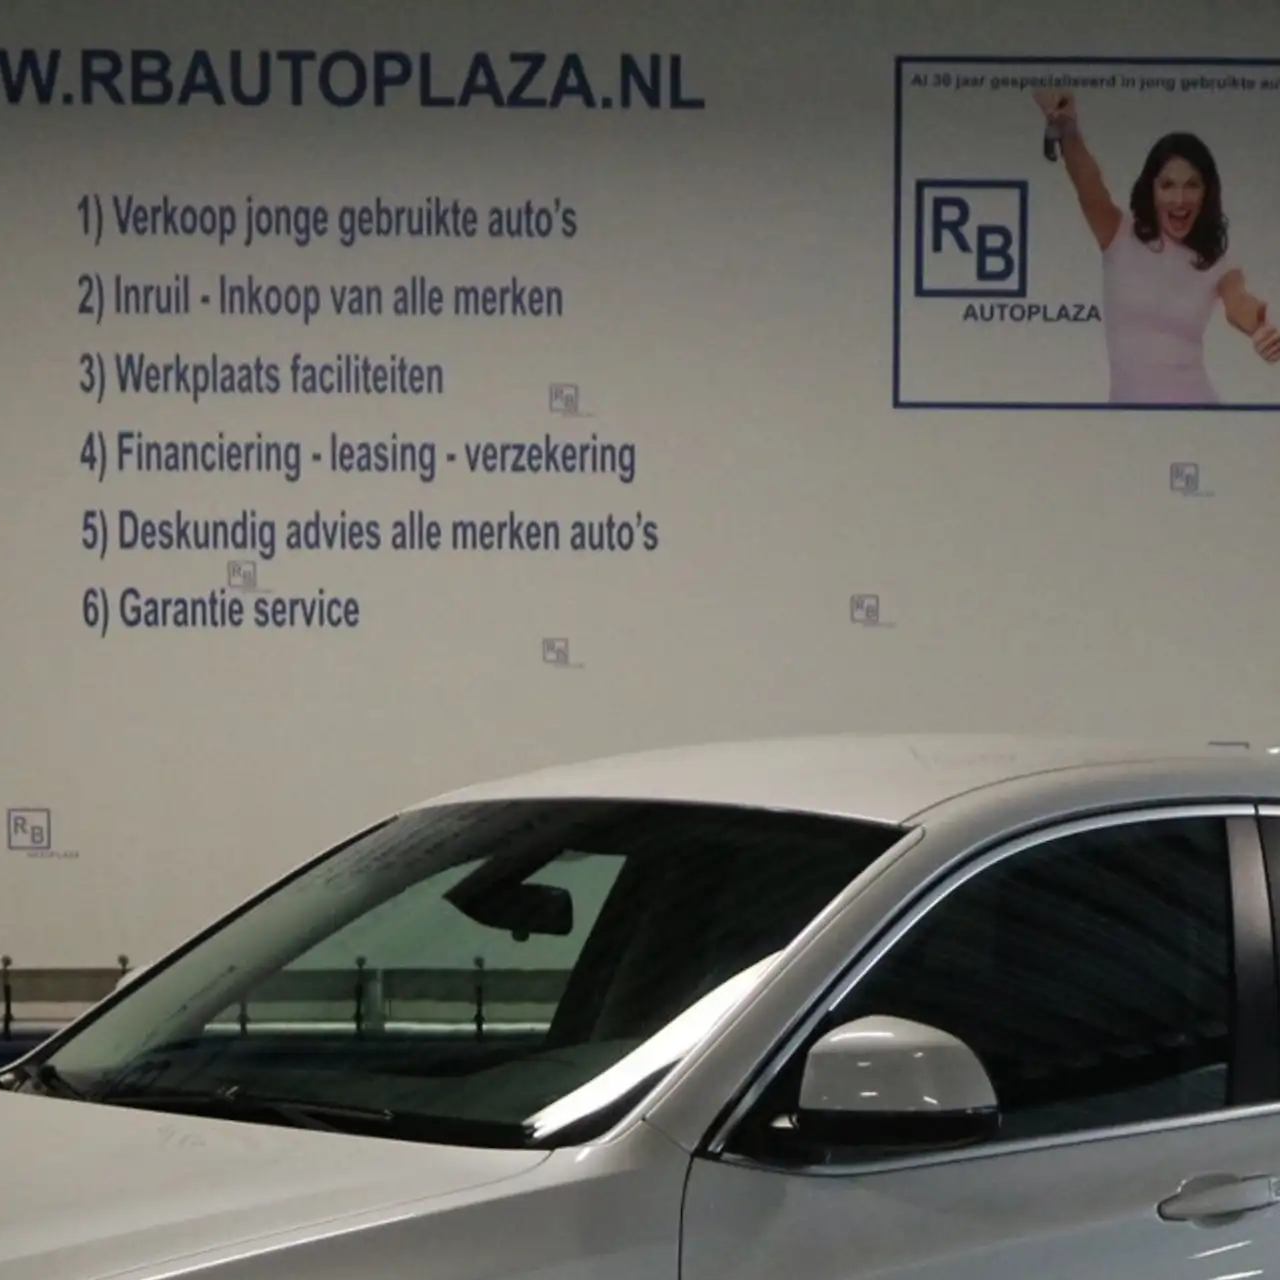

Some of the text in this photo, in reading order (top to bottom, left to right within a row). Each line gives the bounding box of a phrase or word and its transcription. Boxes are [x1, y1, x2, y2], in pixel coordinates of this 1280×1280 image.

[910, 74, 928, 87] Al
[955, 74, 986, 90] jaar
[1121, 75, 1136, 89] in
[1139, 76, 1176, 92] jong
[1180, 76, 1256, 92] gebruikte
[77, 193, 578, 248] 1) Verkoop jonge gebruikte auto's
[77, 273, 105, 325] 2)
[115, 273, 190, 315] Inruil
[219, 273, 321, 326] Inkoop
[330, 284, 383, 316] van
[393, 275, 444, 317] alle
[454, 275, 563, 317] merken
[963, 303, 1102, 323] AUTOPLAZA
[79, 351, 444, 404] 3) Werkplaats faciliteiten
[80, 430, 107, 483] 4)
[117, 431, 301, 483] Financiering
[330, 431, 436, 484] leasing
[464, 432, 636, 484] verzekering
[82, 509, 659, 560] 5) Deskundig advies alle merken auto's
[82, 586, 360, 639] 6) Garantie service
